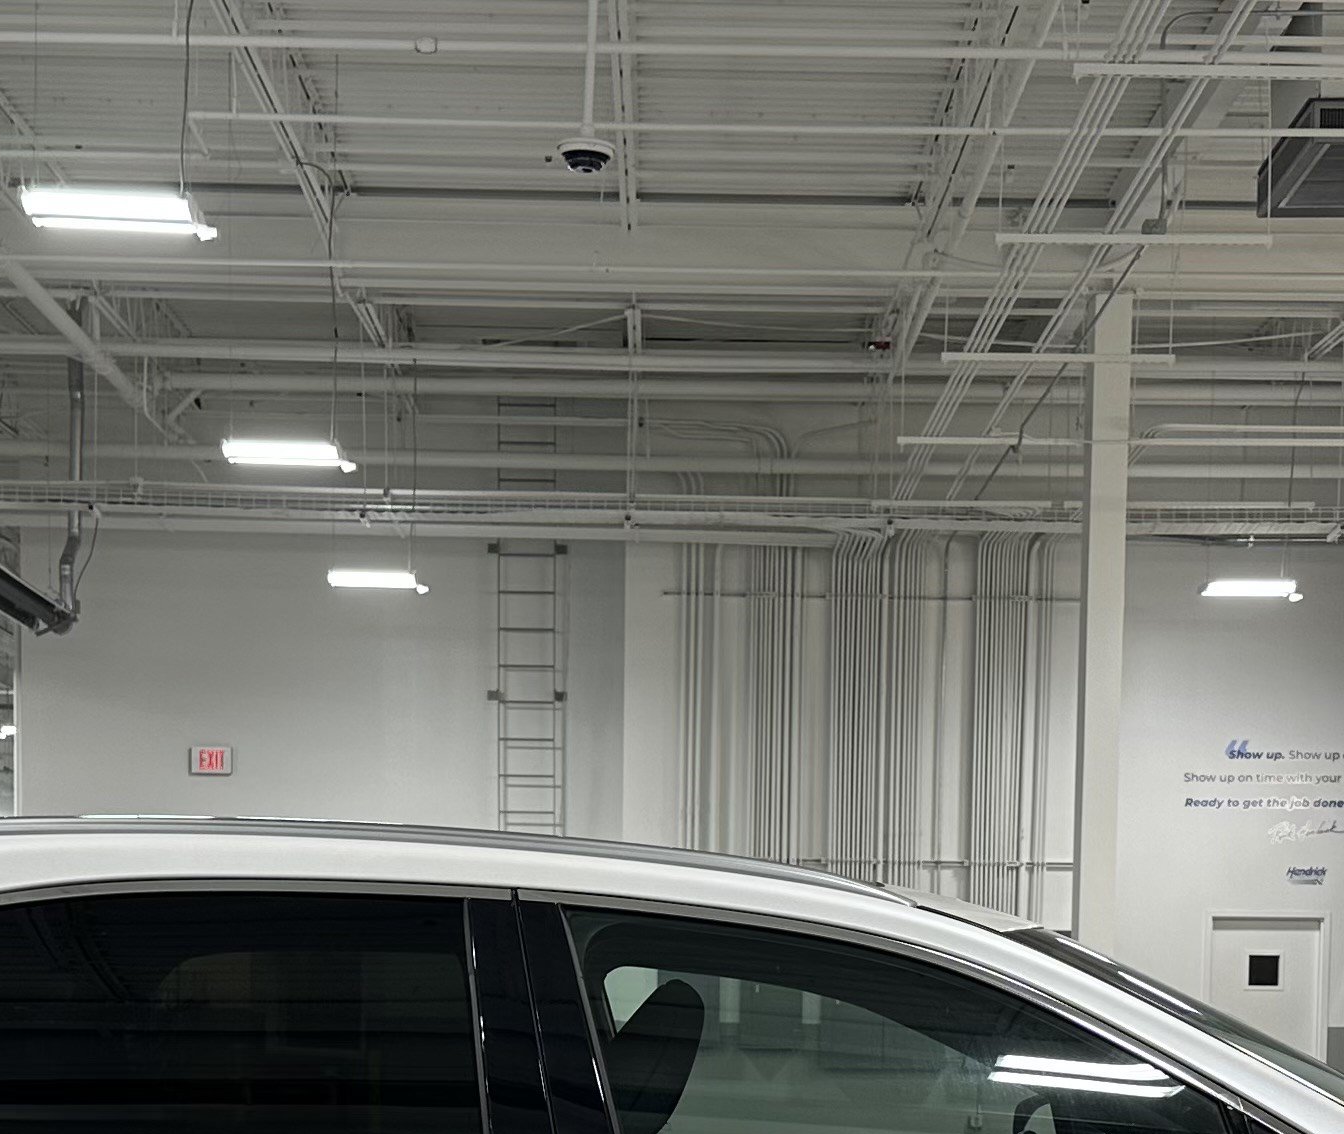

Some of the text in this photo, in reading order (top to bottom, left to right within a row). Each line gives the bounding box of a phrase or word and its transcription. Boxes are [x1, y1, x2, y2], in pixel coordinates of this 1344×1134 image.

[199, 749, 224, 770] EXIT
[1266, 752, 1285, 761] up.
[1288, 749, 1321, 760] Show
[1324, 751, 1340, 761] up
[1183, 772, 1216, 783] Show
[1219, 774, 1235, 784] up
[1237, 774, 1253, 783] on
[1255, 773, 1283, 783] time
[1287, 773, 1312, 783] with
[1316, 773, 1341, 784] your
[1184, 797, 1223, 809] Ready
[1227, 798, 1240, 808] to
[1242, 798, 1263, 809] get
[1266, 798, 1287, 808] the
[1289, 797, 1310, 811] job
[1313, 798, 1344, 808] done
